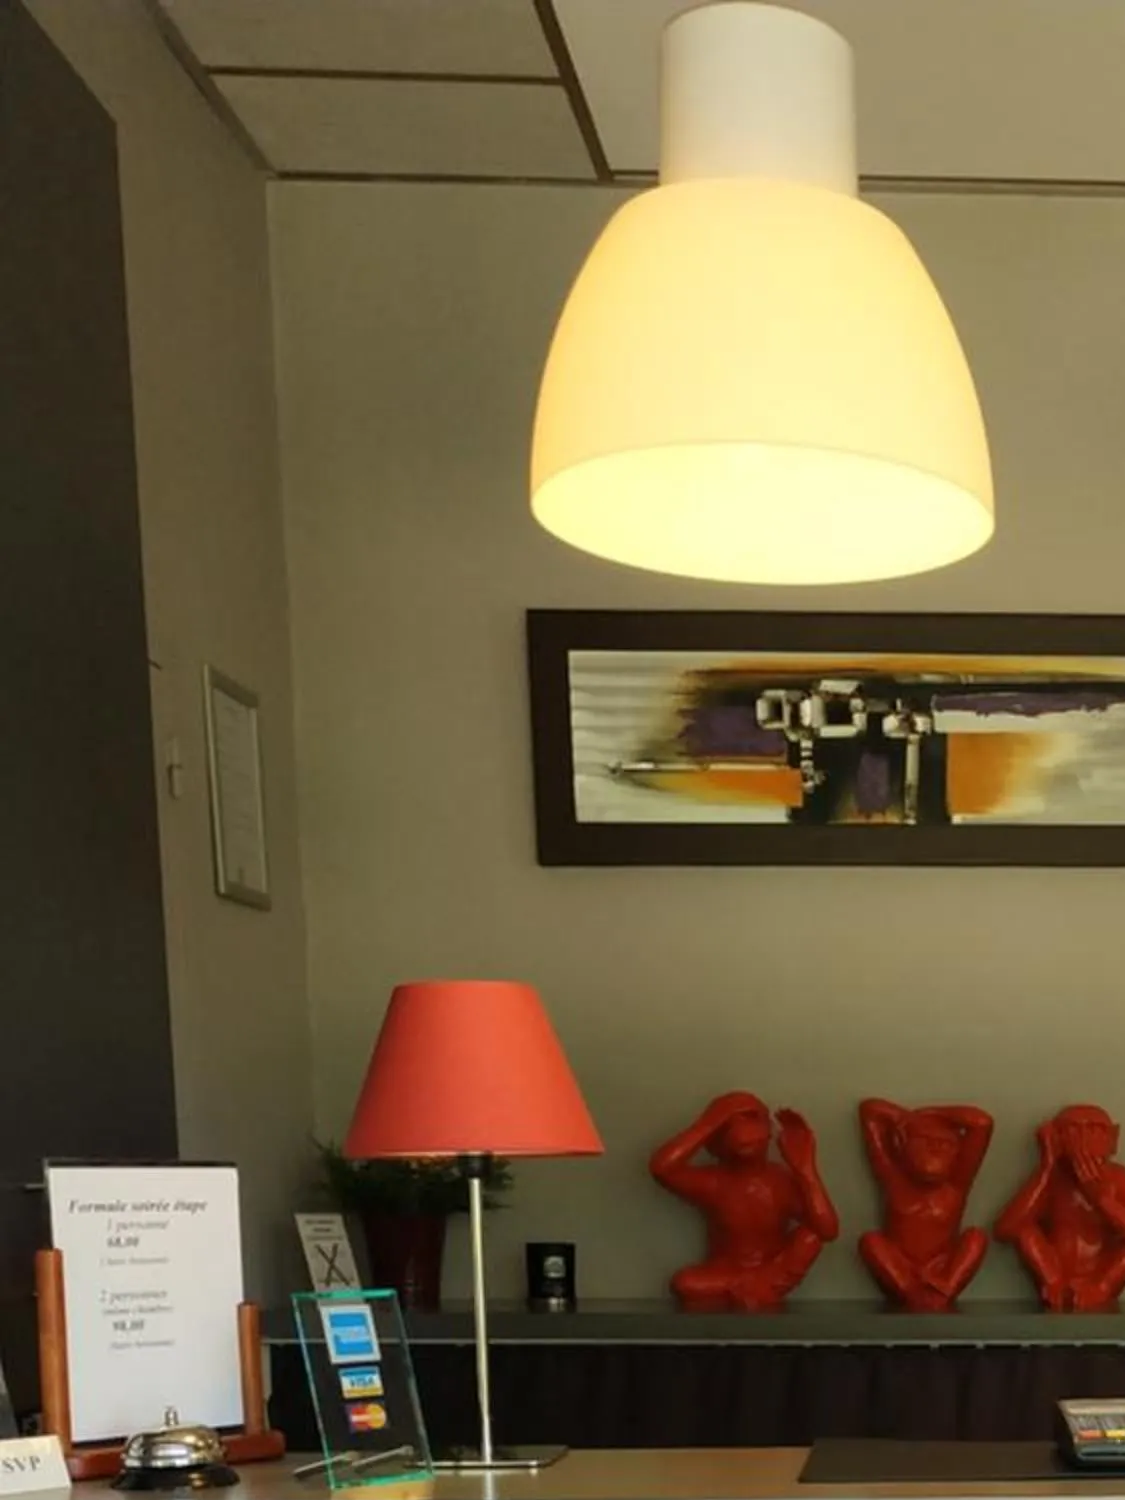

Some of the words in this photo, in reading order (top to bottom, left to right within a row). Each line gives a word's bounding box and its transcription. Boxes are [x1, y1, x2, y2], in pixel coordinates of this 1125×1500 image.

[69, 1199, 126, 1213] Formule
[131, 1198, 170, 1212] soirée
[173, 1199, 207, 1215] étape
[350, 1376, 376, 1388] VISA
[2, 1455, 41, 1473] SVP
